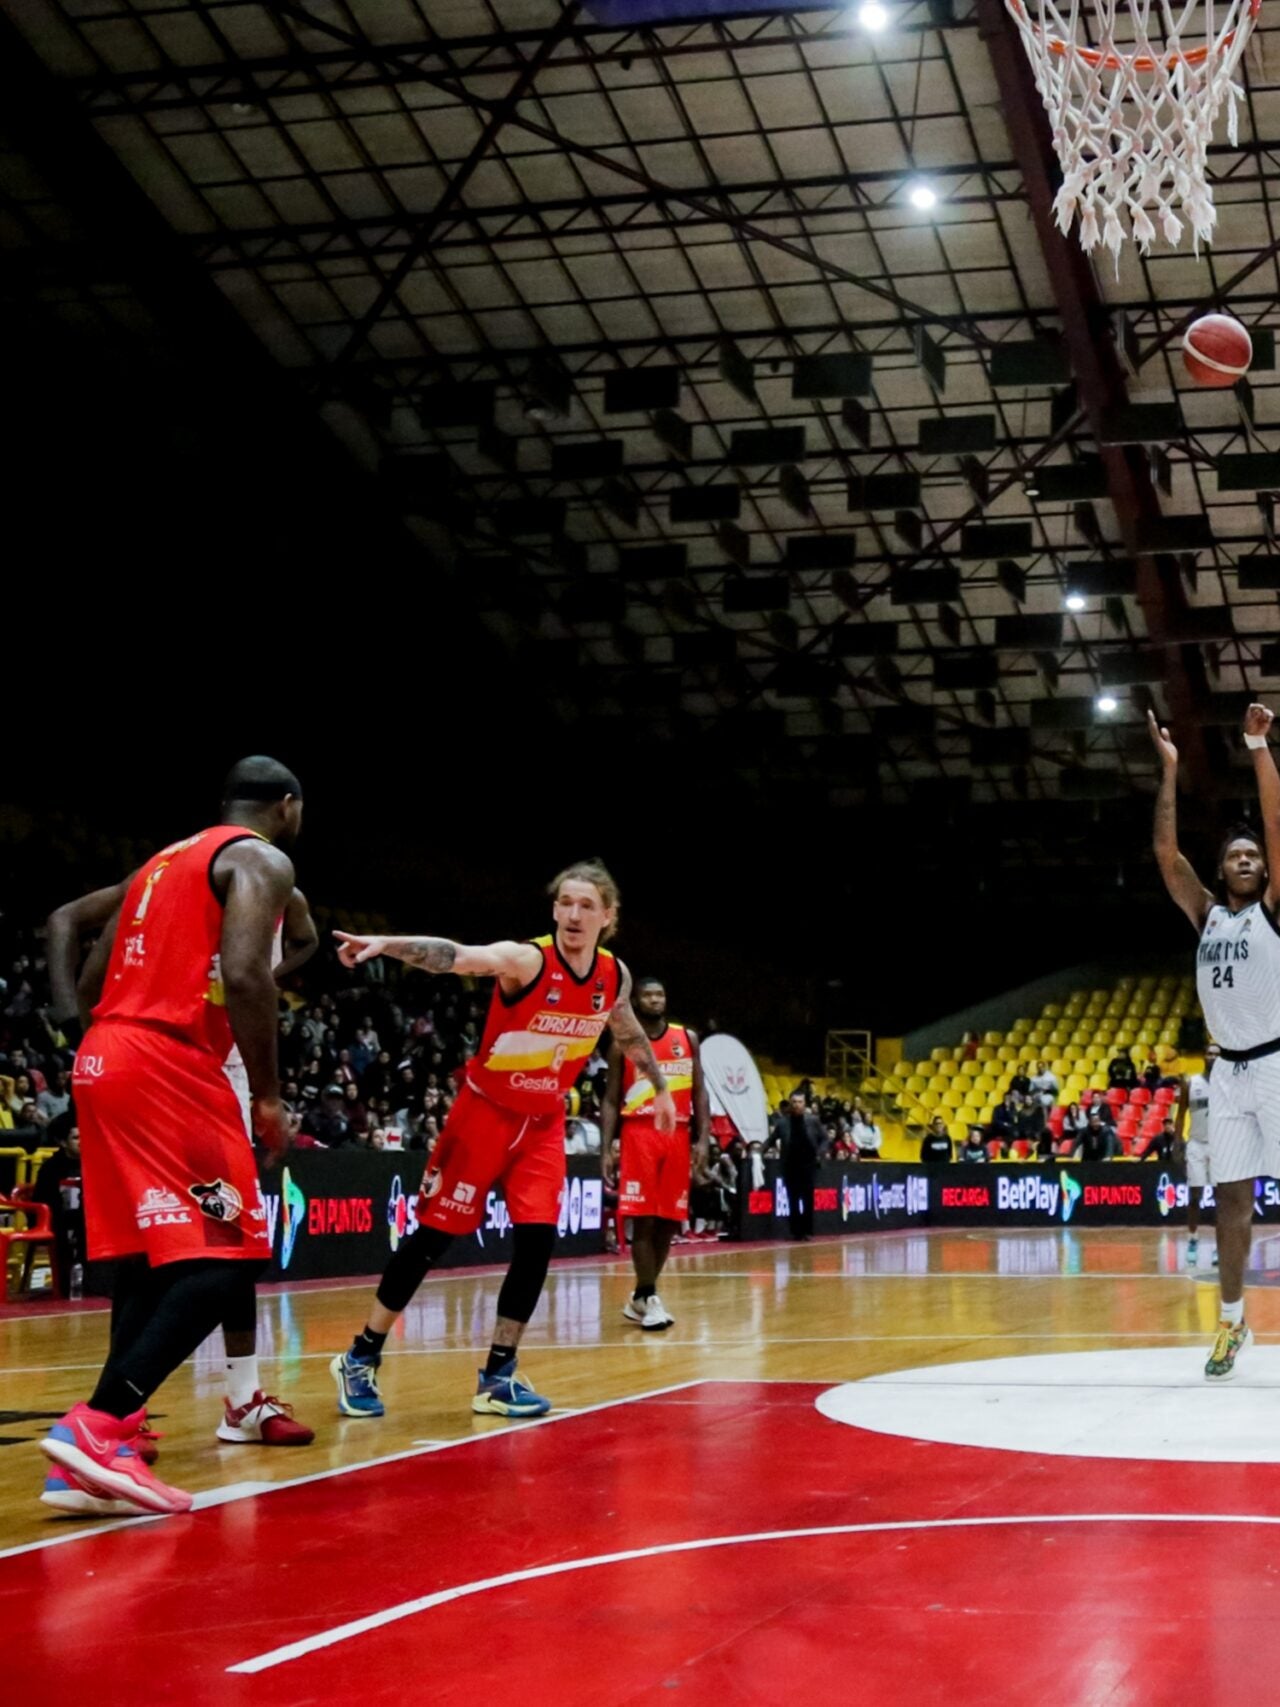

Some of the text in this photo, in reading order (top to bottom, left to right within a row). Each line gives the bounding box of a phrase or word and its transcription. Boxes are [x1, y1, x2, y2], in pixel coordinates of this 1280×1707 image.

[1212, 965, 1234, 988] 24
[510, 1072, 559, 1091] Gestió
[942, 1176, 1142, 1216] RECARGA BetPlay EN PUNTOS
[327, 1198, 373, 1235] PUNTOS
